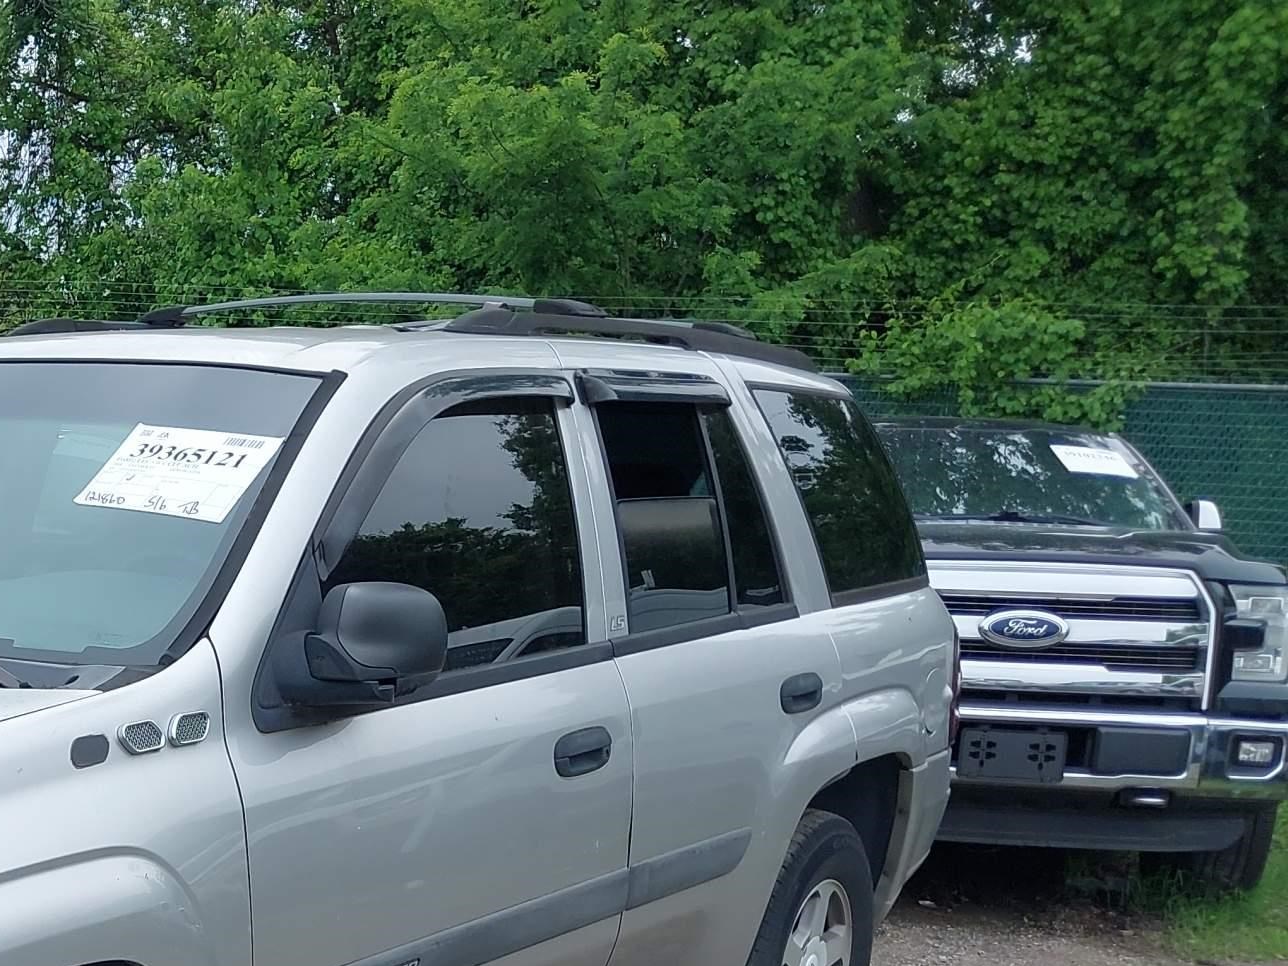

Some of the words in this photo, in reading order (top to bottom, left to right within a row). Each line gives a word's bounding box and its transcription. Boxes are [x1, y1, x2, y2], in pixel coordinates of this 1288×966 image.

[129, 442, 249, 469] 39365121
[609, 615, 626, 632] LS
[1003, 618, 1049, 637] Ford
